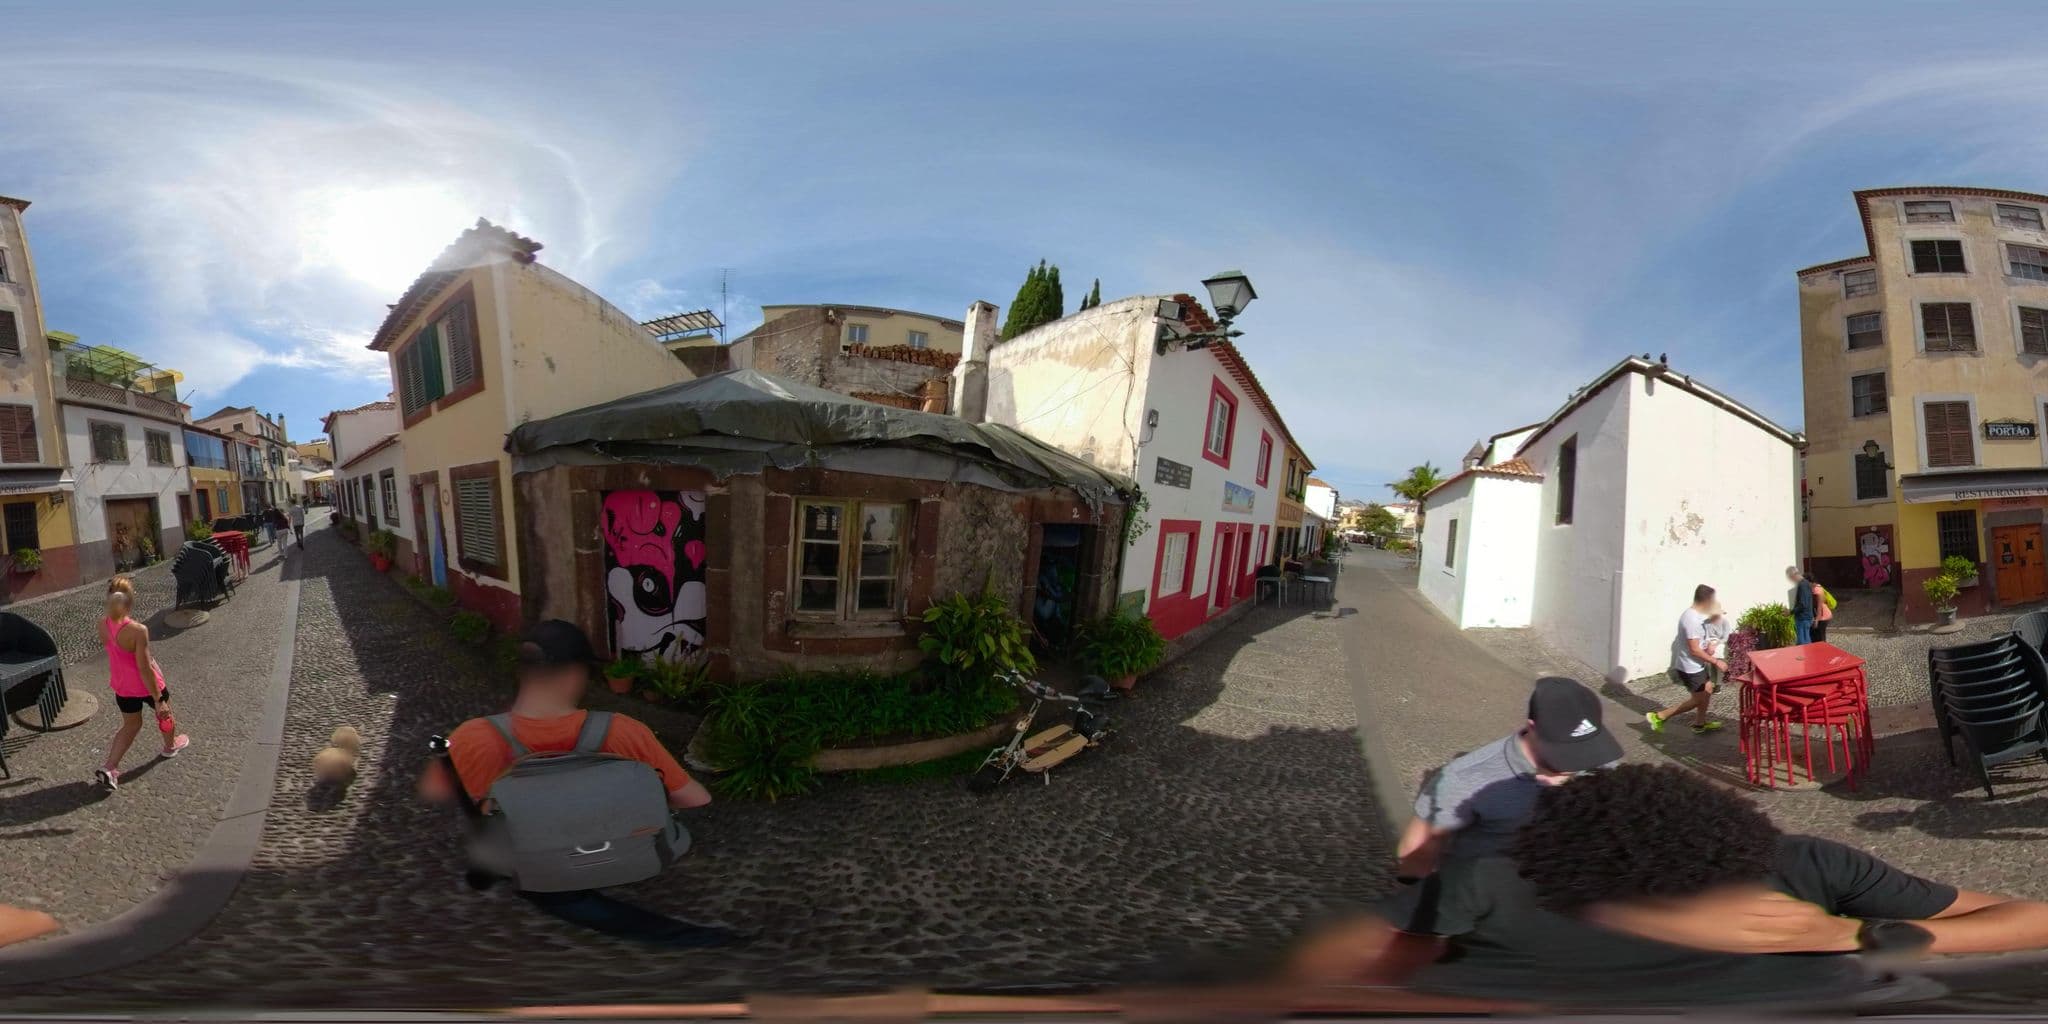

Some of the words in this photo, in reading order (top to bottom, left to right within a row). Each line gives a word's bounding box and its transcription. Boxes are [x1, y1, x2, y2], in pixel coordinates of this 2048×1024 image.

[1989, 425, 2030, 436] PORTÃO
[1954, 487, 2028, 499] RESTAURANTE
[1072, 507, 1080, 518] 2
